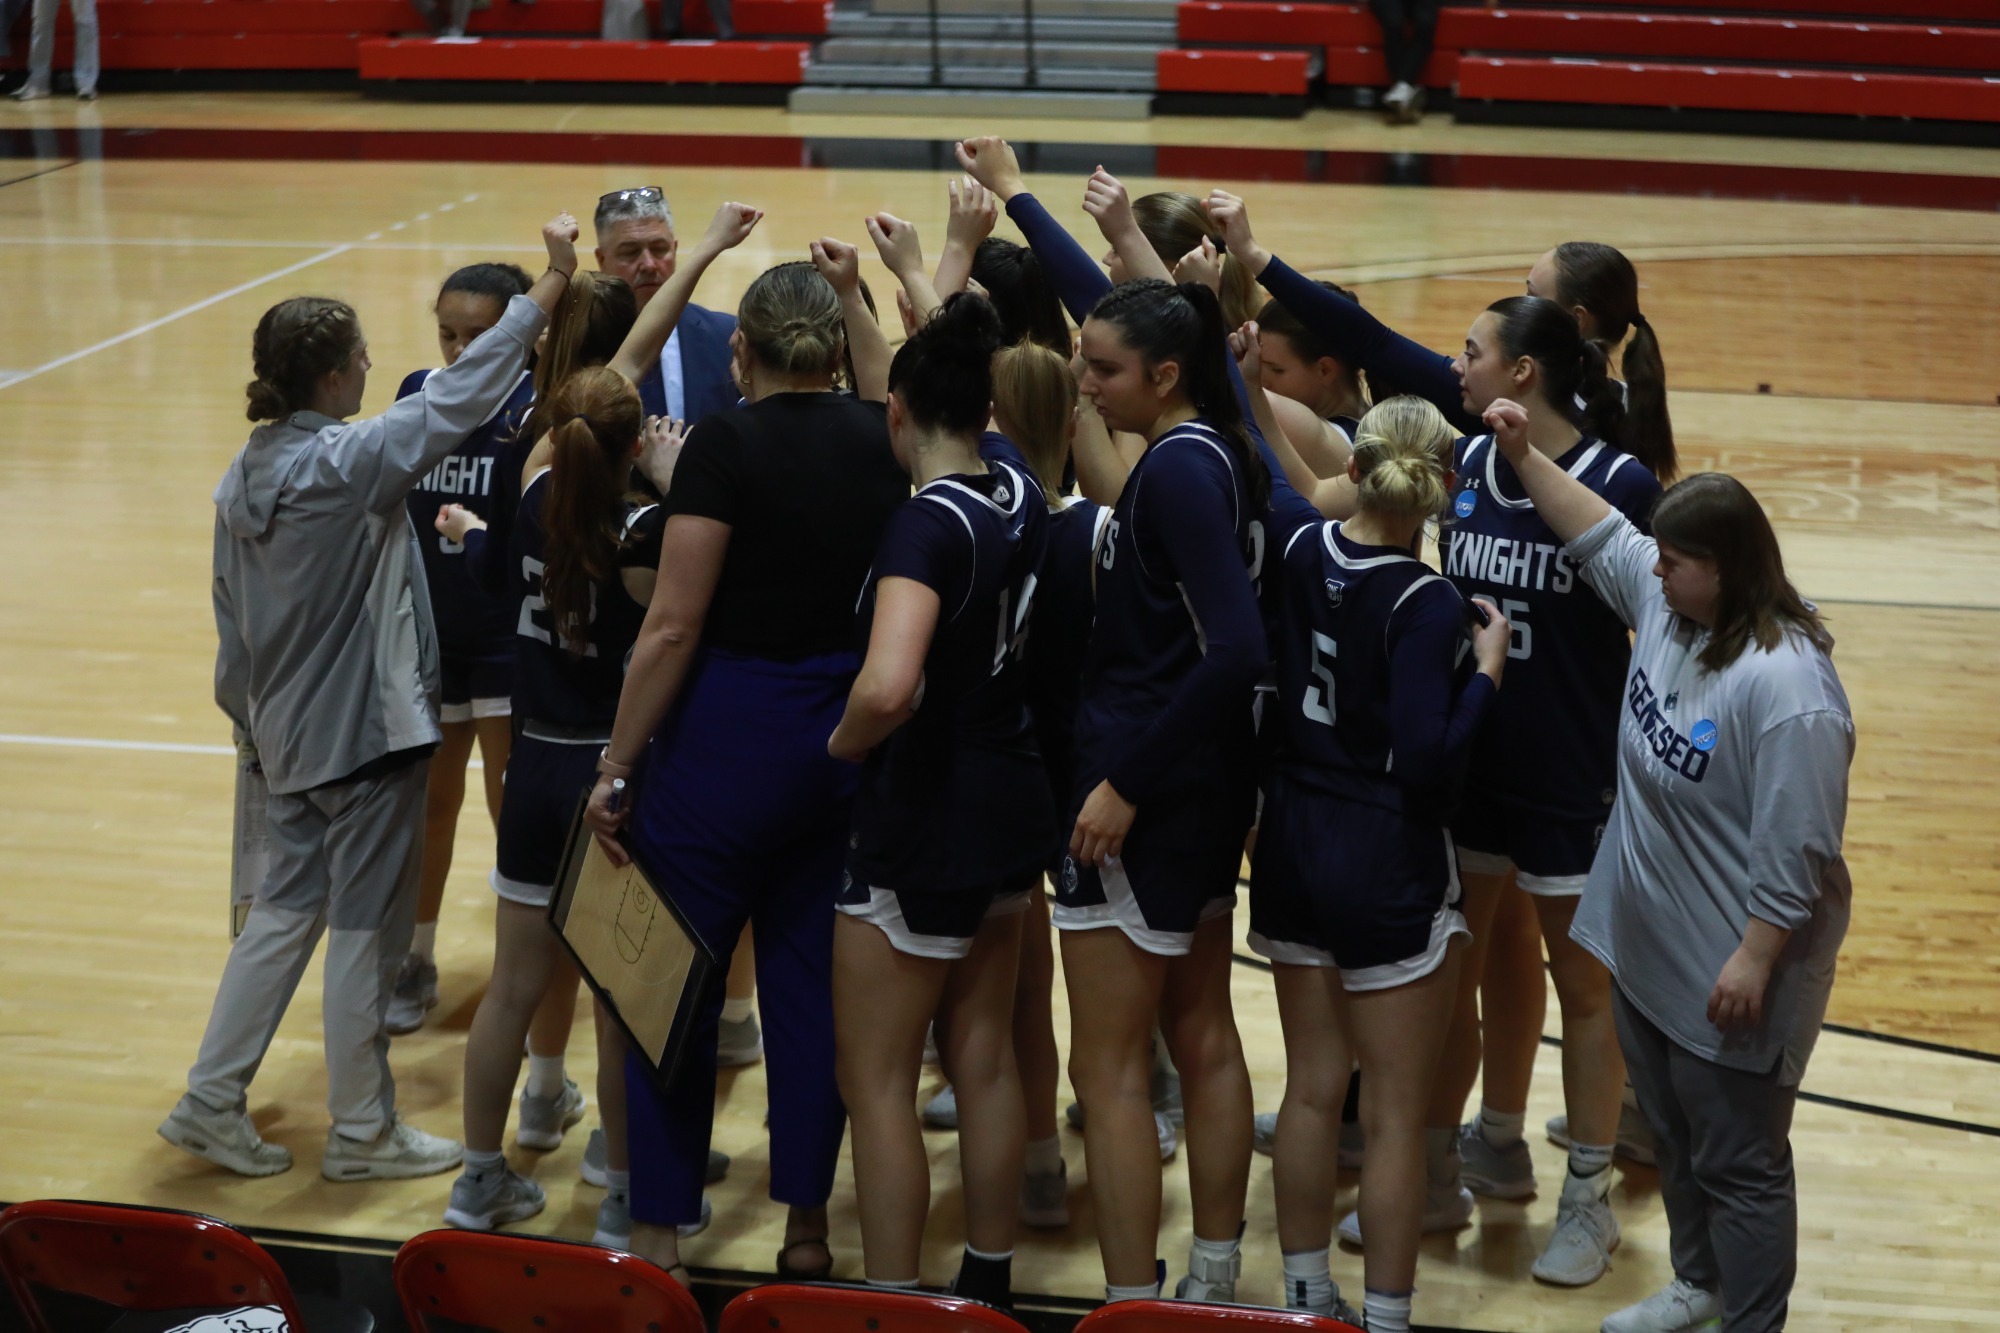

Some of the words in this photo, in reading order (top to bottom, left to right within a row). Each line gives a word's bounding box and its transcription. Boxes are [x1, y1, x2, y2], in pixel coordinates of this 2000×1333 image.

[411, 455, 496, 496] IGHT
[1446, 530, 1574, 594] KNIGHTS
[1471, 593, 1533, 661] 5
[1302, 628, 1338, 728] 5
[1622, 713, 1675, 793] ASKETBALL
[1629, 667, 1710, 783] GENESEO
